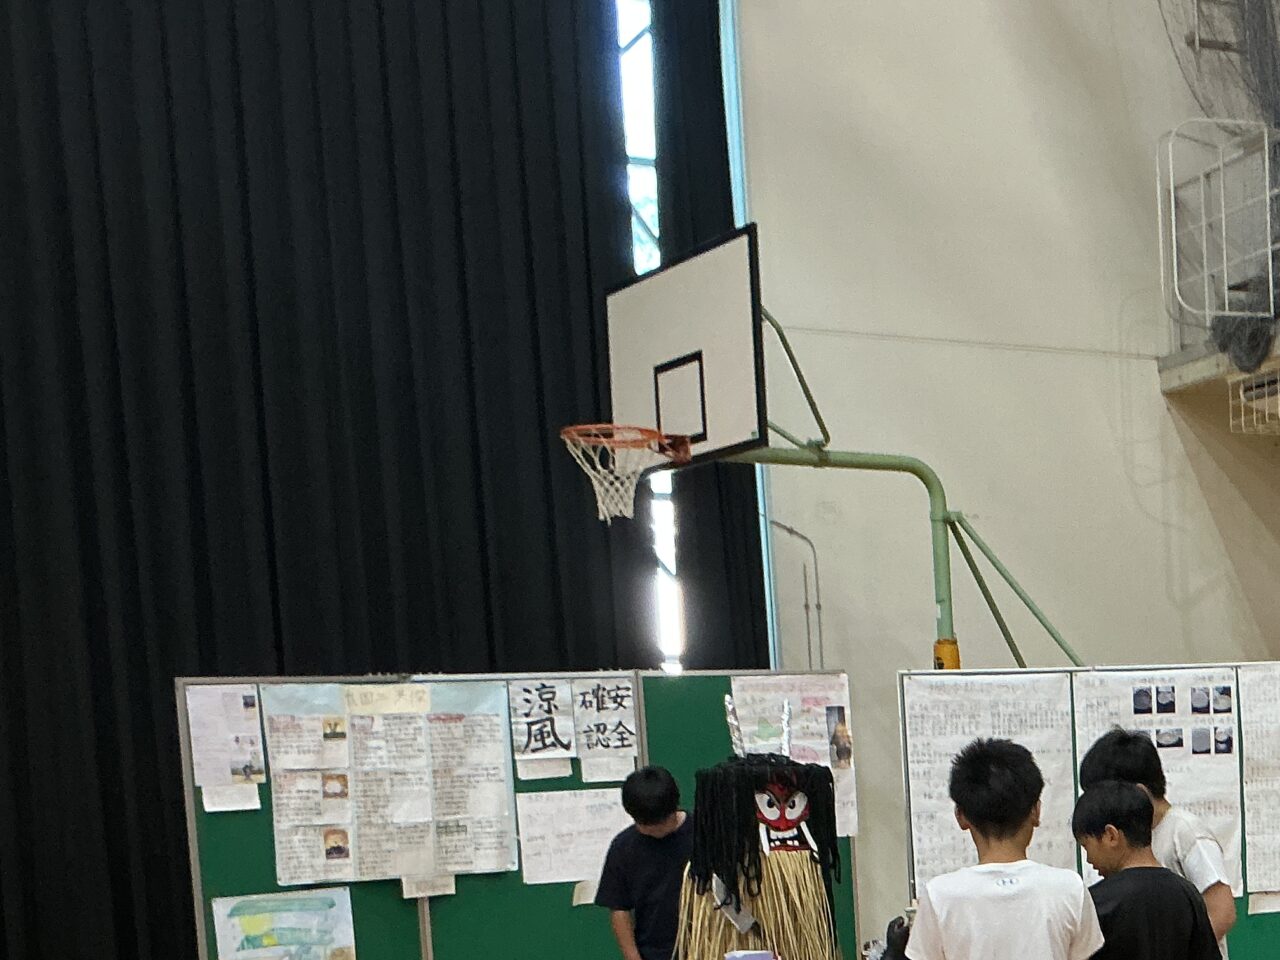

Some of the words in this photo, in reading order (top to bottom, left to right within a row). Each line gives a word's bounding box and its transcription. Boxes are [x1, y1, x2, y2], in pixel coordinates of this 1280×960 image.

[522, 683, 571, 754] 涼風
[579, 683, 610, 750] 確認
[606, 684, 636, 749] 安全
